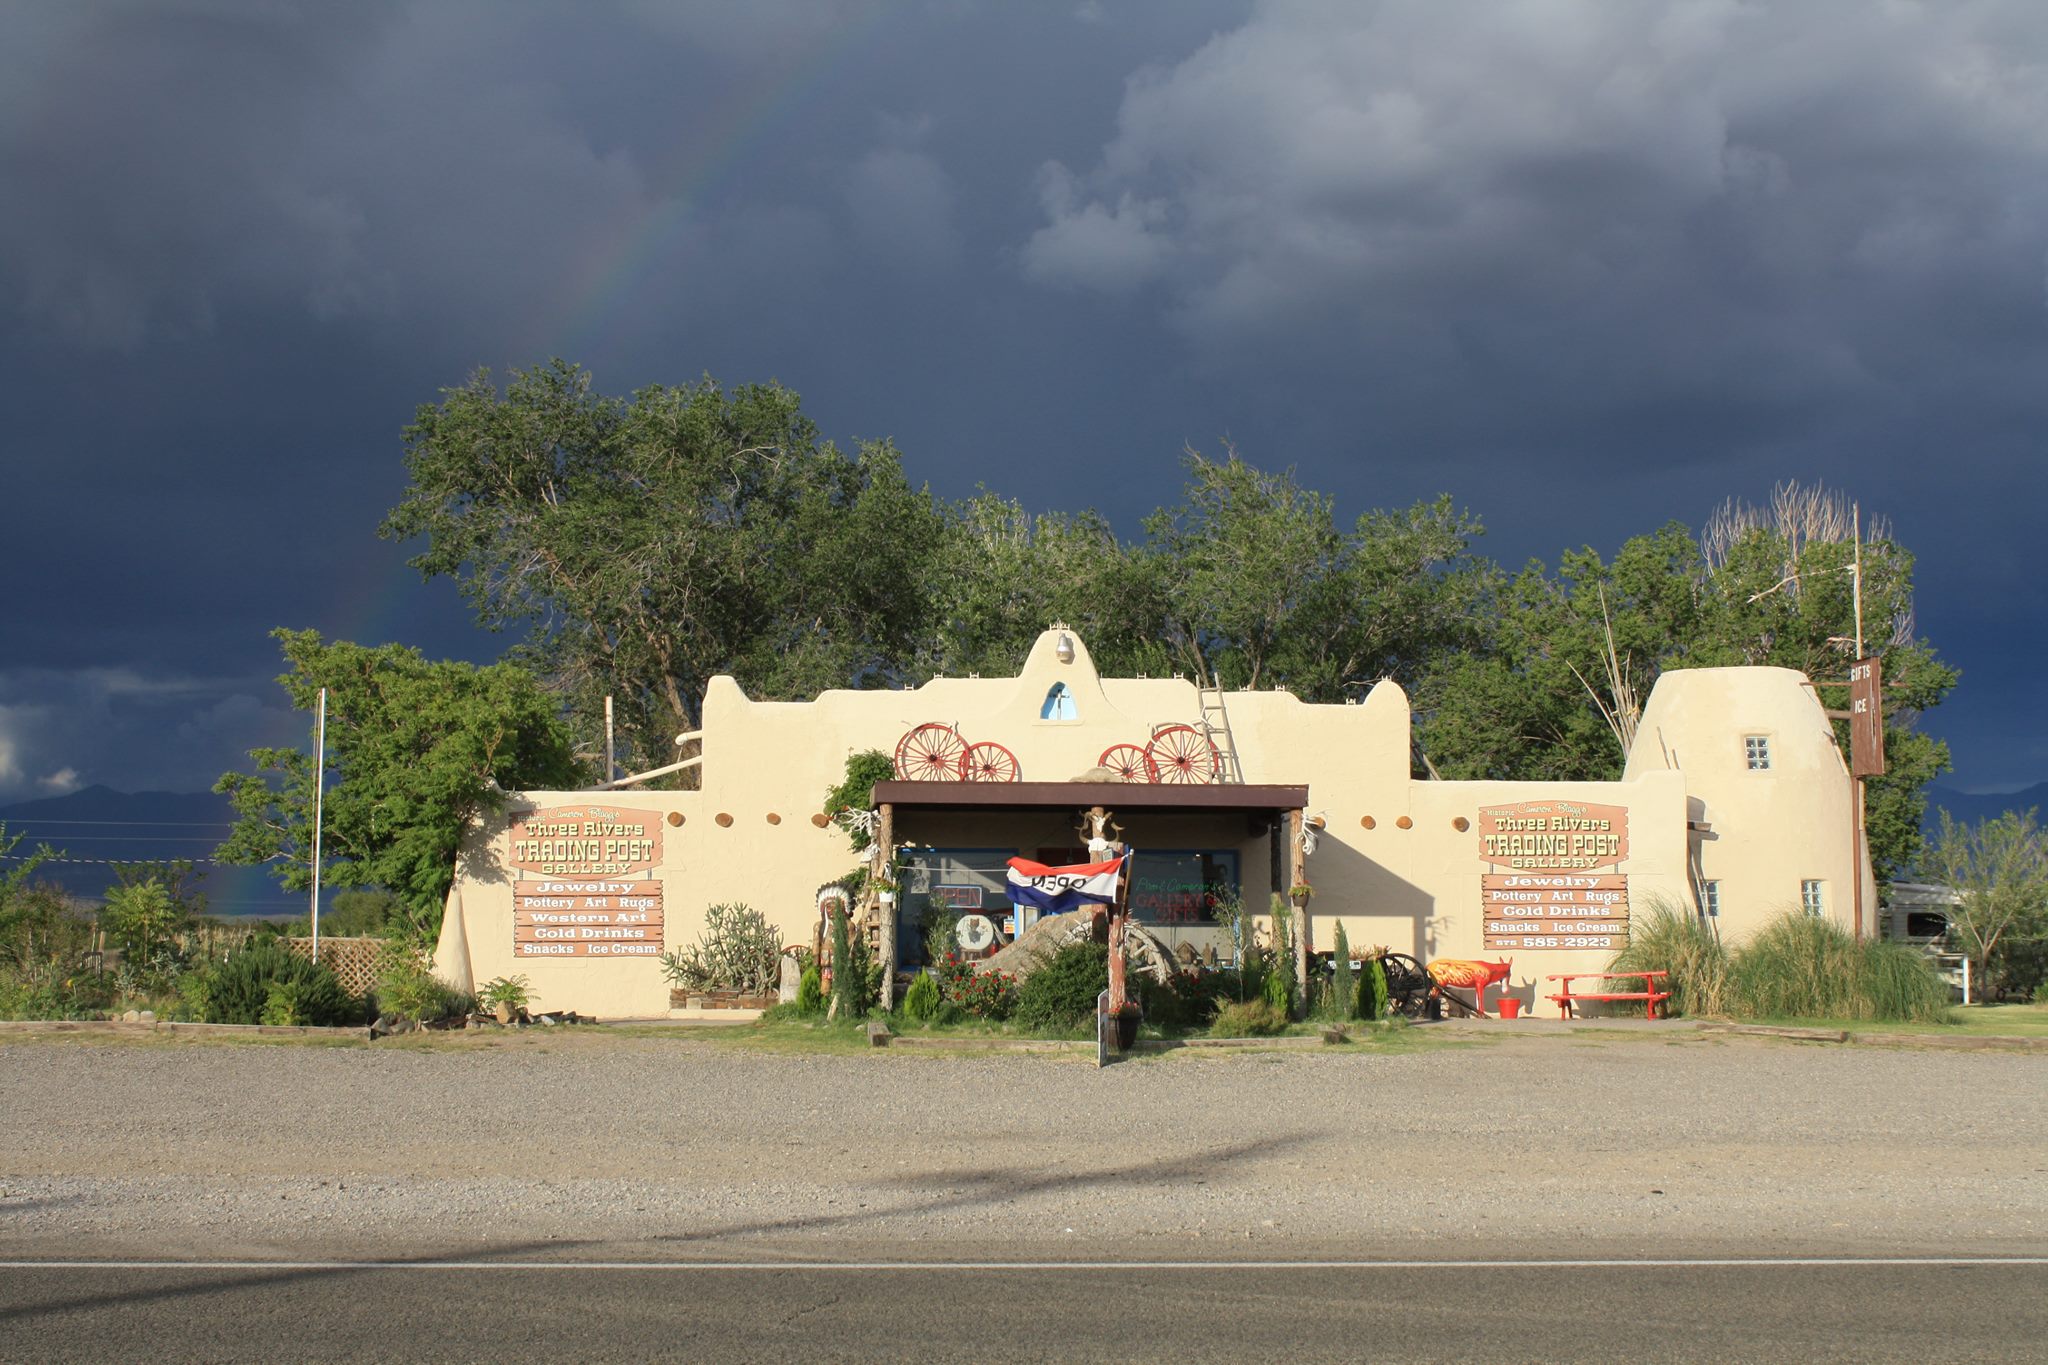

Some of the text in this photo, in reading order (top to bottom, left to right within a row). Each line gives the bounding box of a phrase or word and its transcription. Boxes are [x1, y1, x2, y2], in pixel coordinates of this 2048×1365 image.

[1850, 664, 1871, 682] GIFTS
[1854, 698, 1867, 714] ICE
[525, 820, 645, 837] Three Rivers
[1494, 815, 1611, 832] Three Rivers
[515, 839, 655, 862] TRADING POST
[1484, 834, 1621, 857] TRADING POST
[541, 863, 633, 875] GALLERY
[1511, 857, 1600, 869] GALLERY
[536, 882, 636, 895] Jewelry
[1504, 876, 1602, 889] Jewelry
[524, 897, 654, 912] Pottery Art Rugs
[1492, 890, 1620, 906] Pottery Art Rugs
[1503, 905, 1611, 916] Cold Drinks
[530, 913, 647, 923] Western Art
[534, 927, 645, 939] Cold Drinks
[1490, 922, 1620, 932] Snacks Ice Cream
[523, 943, 657, 954] Snacks Ice Cream
[1523, 937, 1611, 947] 585-2923
